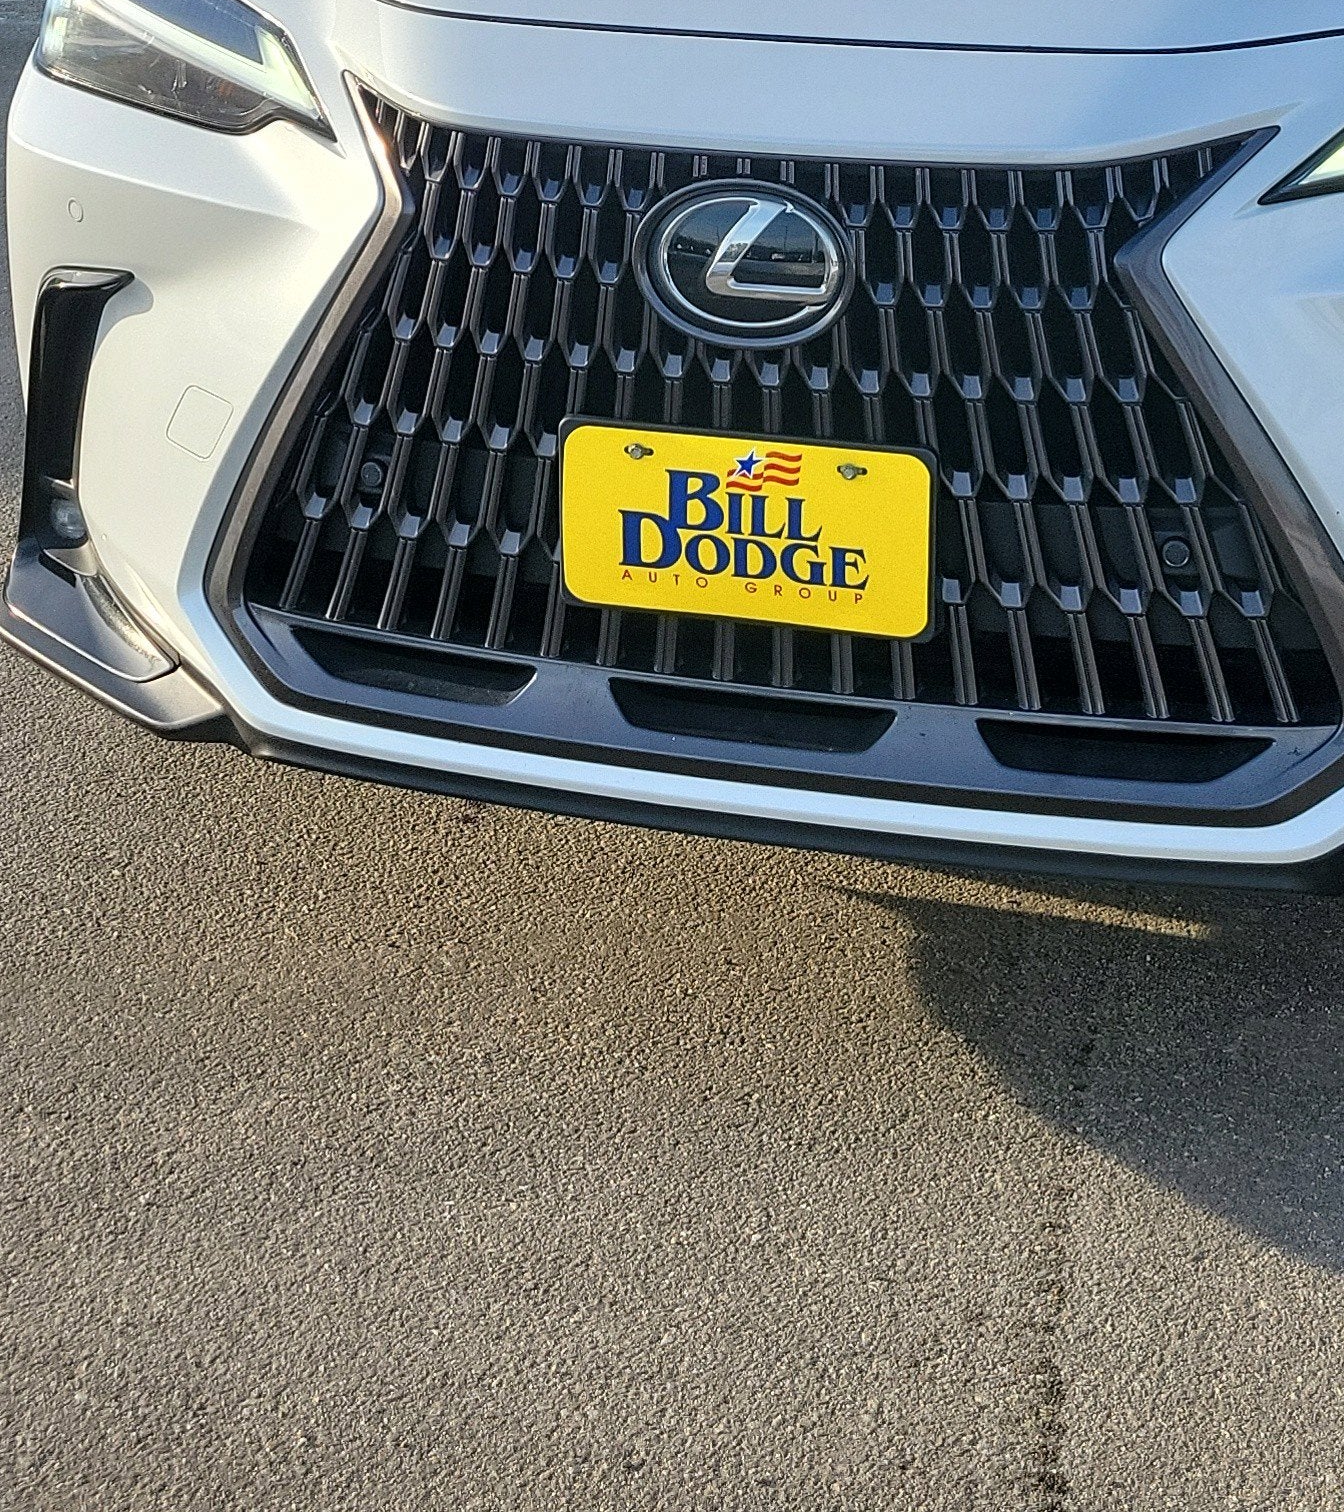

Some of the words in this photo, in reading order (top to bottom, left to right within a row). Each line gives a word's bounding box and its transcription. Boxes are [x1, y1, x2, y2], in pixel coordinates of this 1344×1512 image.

[665, 468, 822, 542] BILL
[618, 509, 870, 591] DODGE
[621, 569, 708, 589] AUTO
[745, 582, 864, 605] GROUP
